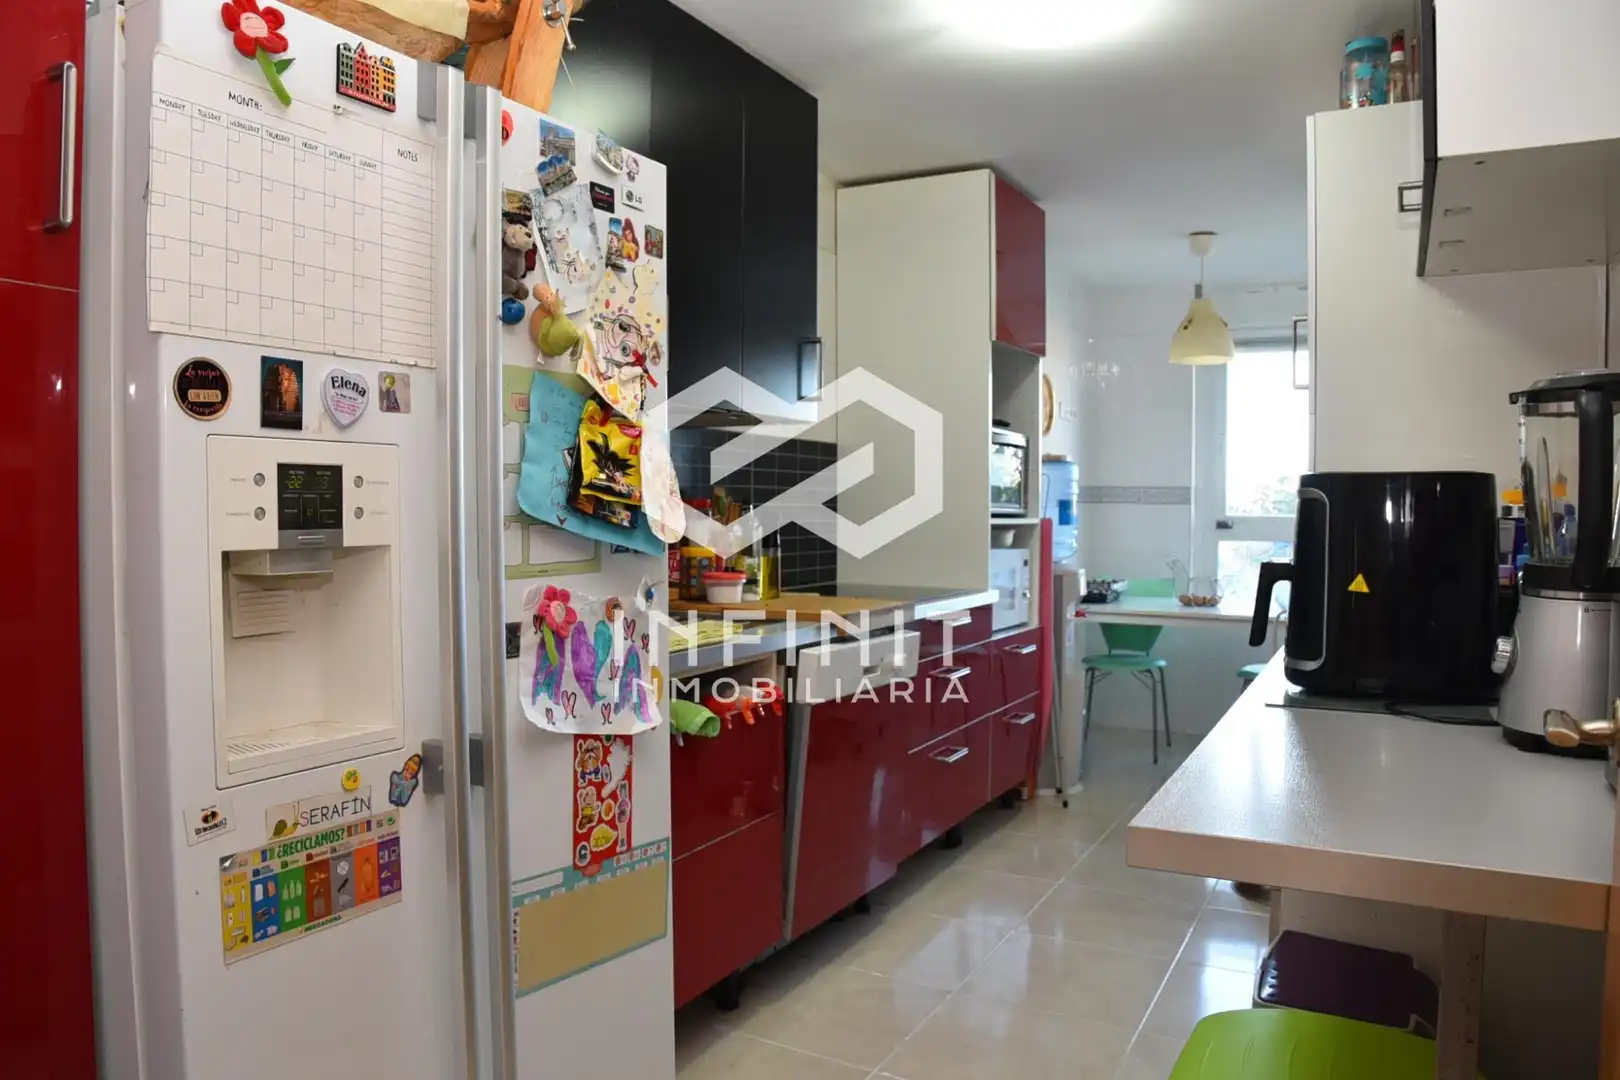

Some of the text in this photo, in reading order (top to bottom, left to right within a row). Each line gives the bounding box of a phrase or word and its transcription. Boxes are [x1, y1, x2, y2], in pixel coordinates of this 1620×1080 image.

[159, 97, 186, 111] MONDAY
[228, 91, 263, 111] MONTH:
[197, 108, 222, 121] TUESDAY
[265, 129, 290, 143] THURSDAY
[397, 148, 418, 163] NOTES
[331, 375, 367, 398] Elena
[276, 828, 346, 858] ¿RECICLAMOS?
